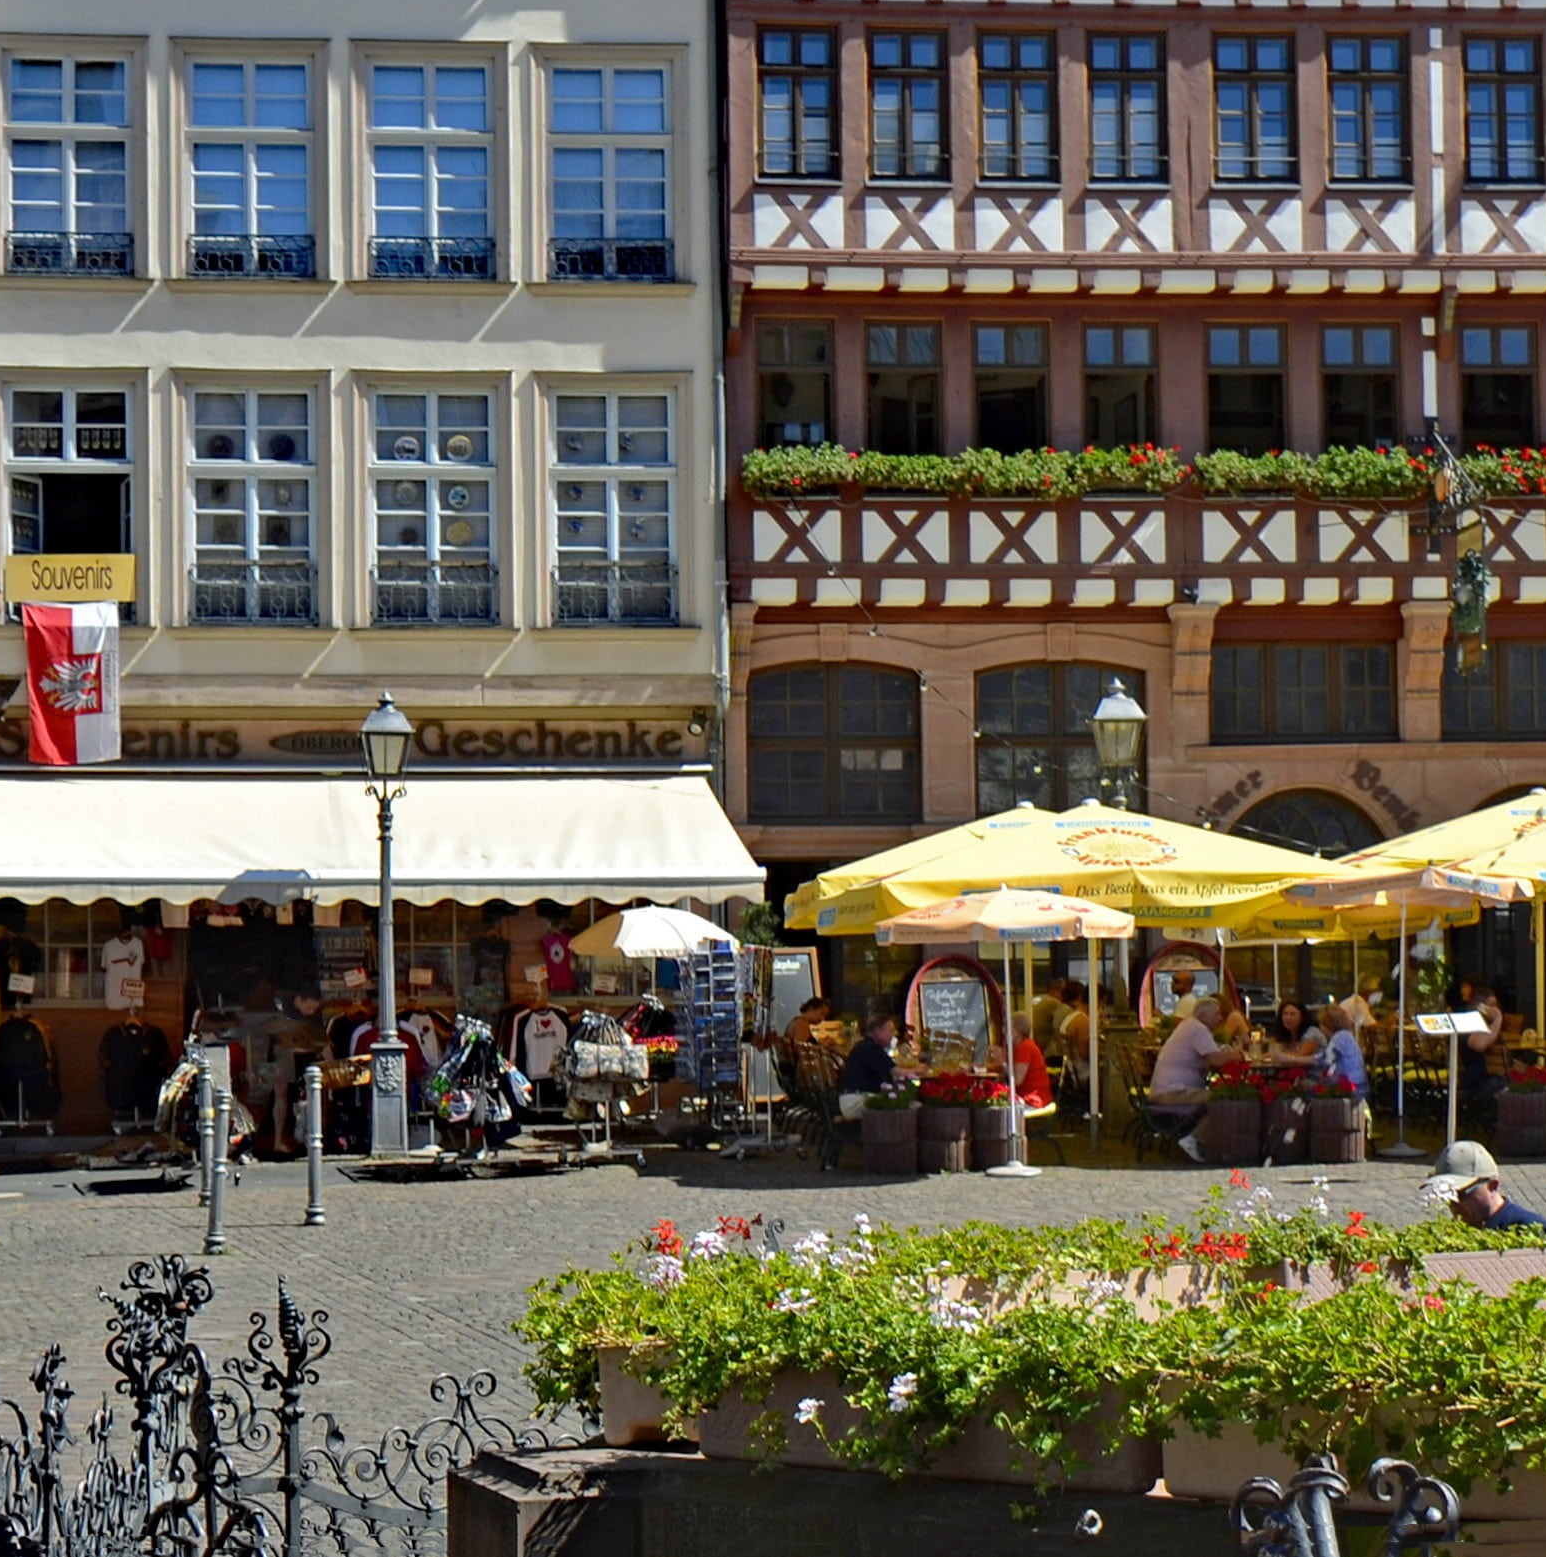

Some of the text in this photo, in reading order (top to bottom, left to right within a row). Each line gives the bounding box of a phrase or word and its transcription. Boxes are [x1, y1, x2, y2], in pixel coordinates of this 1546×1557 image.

[31, 559, 113, 591] Souvenirs
[414, 719, 684, 758] Geschenke
[1350, 759, 1422, 832] Bemb
[1075, 883, 1102, 898] Das
[1105, 880, 1139, 896] Beste
[1140, 883, 1165, 896] was
[1169, 882, 1188, 895] ein
[1193, 881, 1224, 900] Apfel
